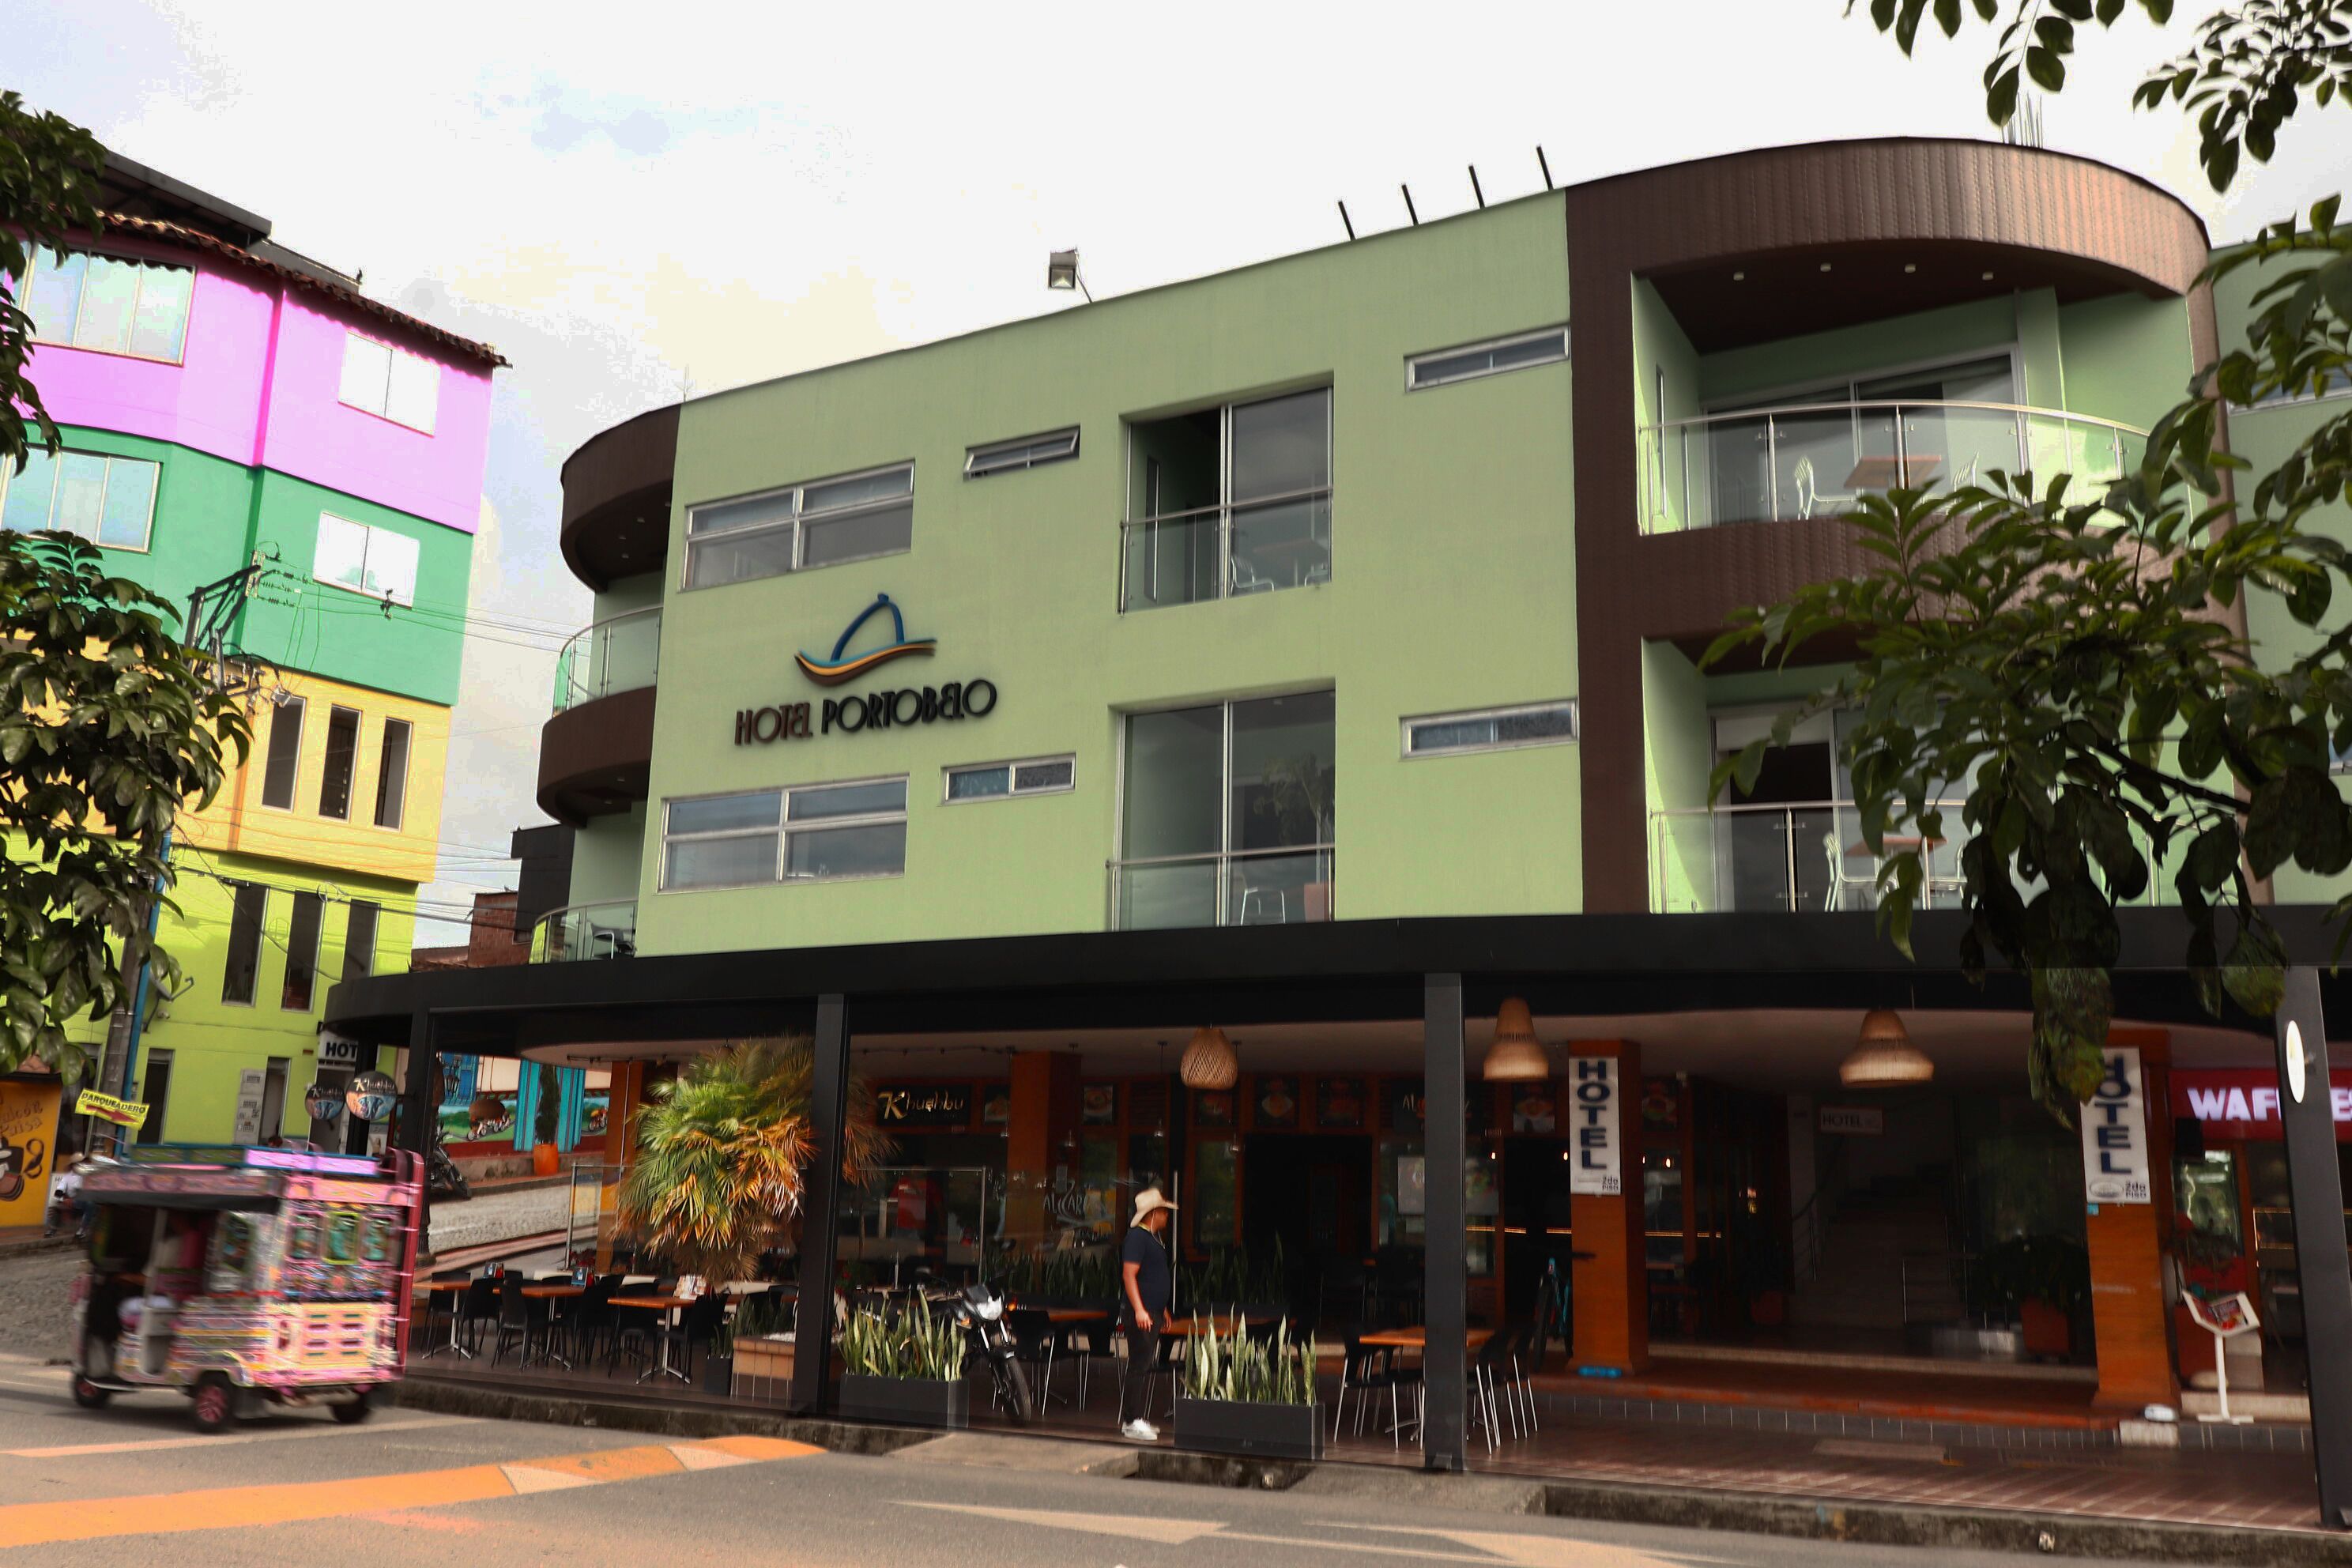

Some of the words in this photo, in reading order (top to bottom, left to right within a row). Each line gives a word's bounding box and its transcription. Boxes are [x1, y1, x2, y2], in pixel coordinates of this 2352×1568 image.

[734, 702, 813, 746] HOTEL
[821, 678, 997, 735] PORTOBELO
[325, 1042, 358, 1059] HOT
[81, 1092, 146, 1114] PARQUEADERO
[1577, 1060, 1611, 1170] HOTEL
[2186, 1086, 2352, 1121] WAFE
